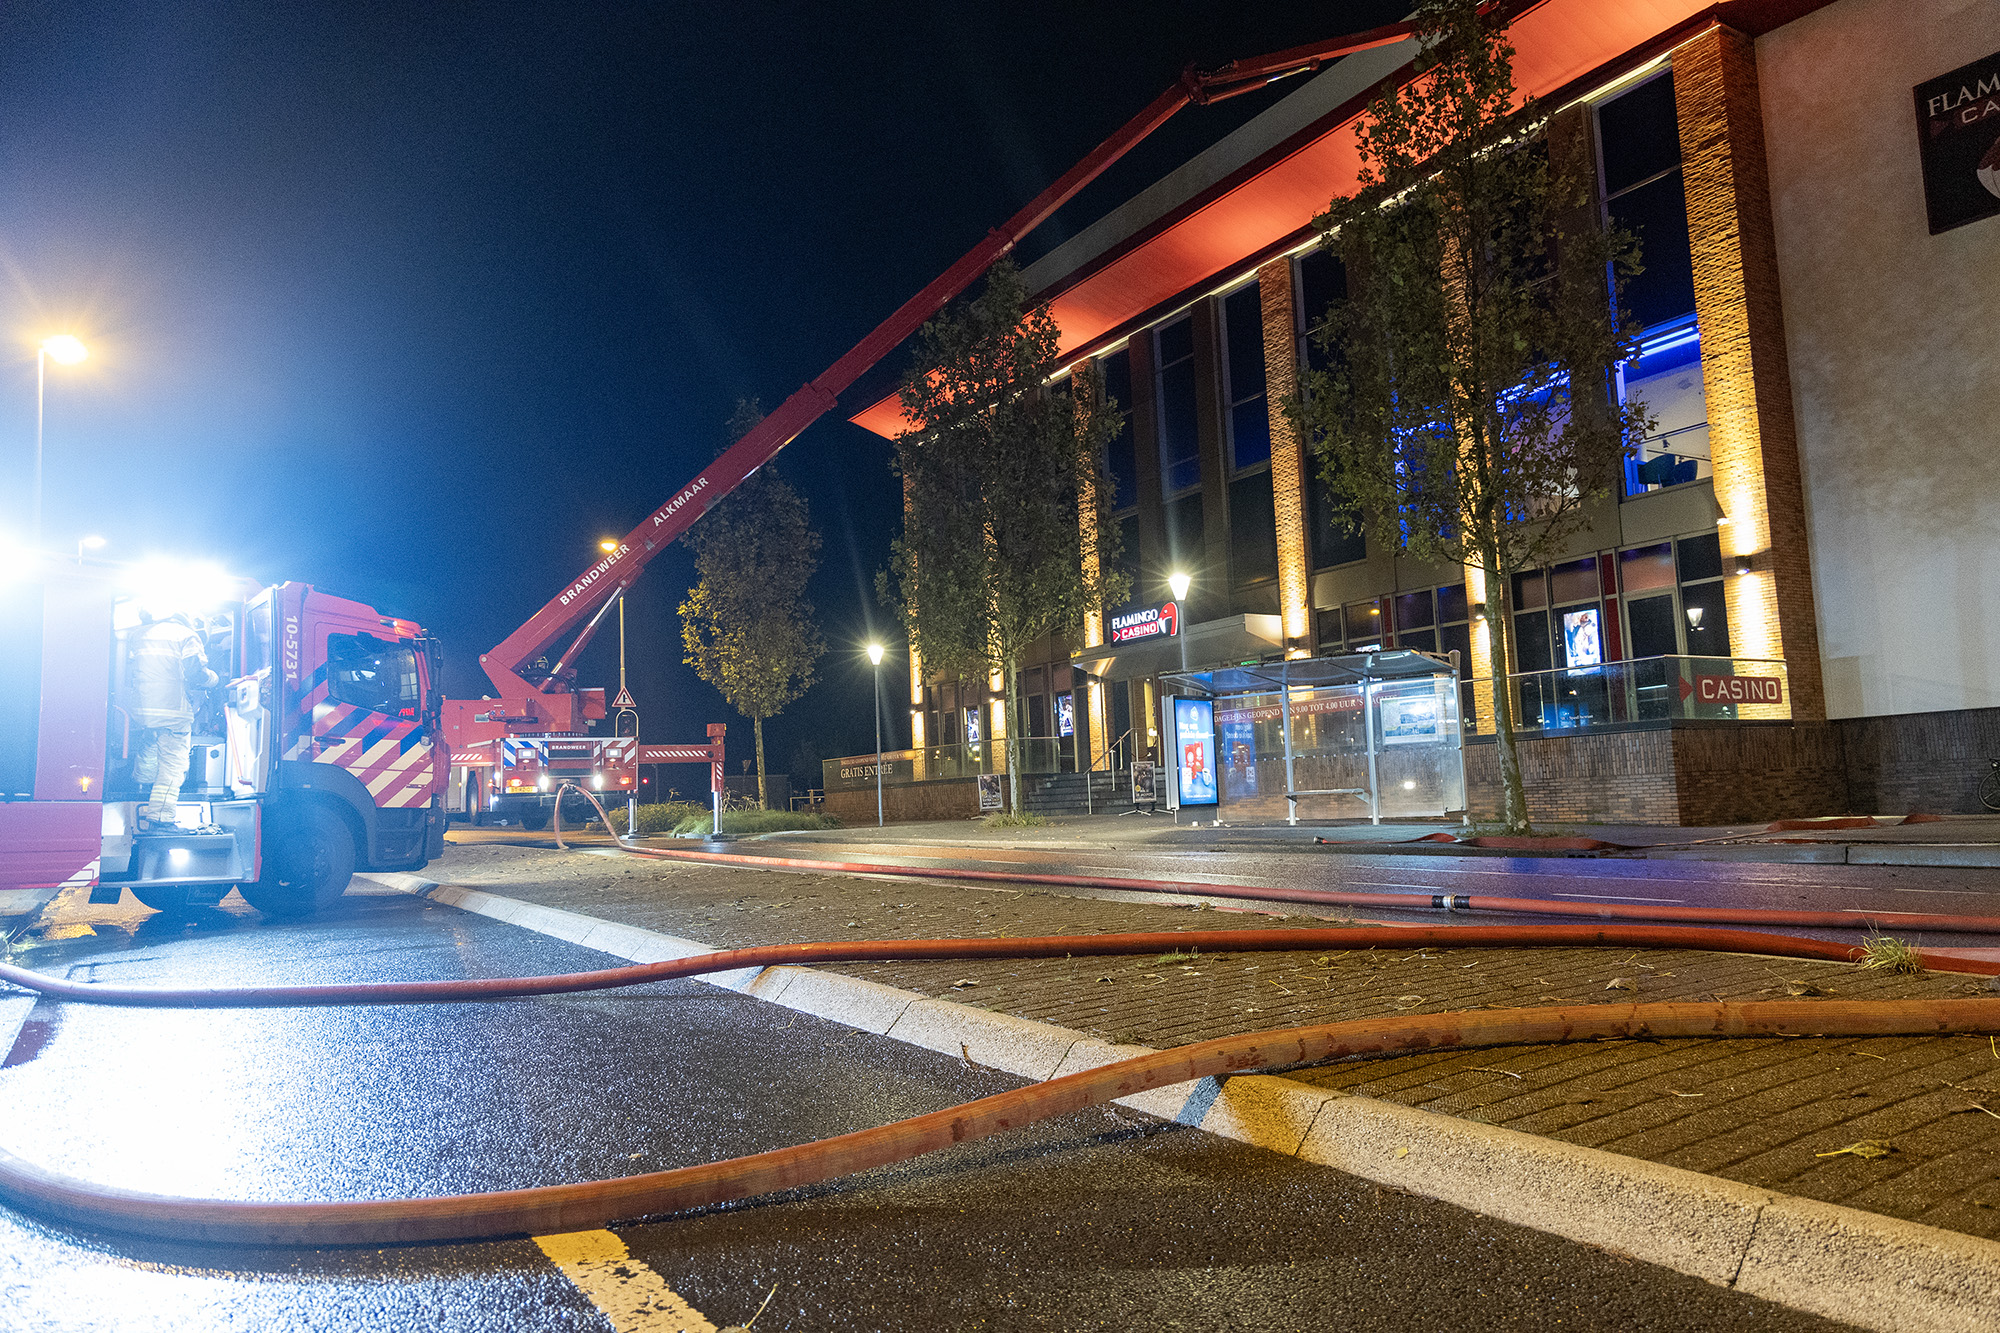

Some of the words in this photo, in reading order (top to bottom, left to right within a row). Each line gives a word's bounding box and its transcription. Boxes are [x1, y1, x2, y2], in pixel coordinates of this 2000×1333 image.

[652, 476, 709, 527] ALKMAAR
[559, 543, 630, 606] BRANDWEER
[1112, 609, 1158, 629] FLAMINGO
[1121, 623, 1156, 639] CASINO
[286, 615, 298, 680] 10-5731
[1701, 678, 1779, 701] CASINO
[1247, 708, 1280, 719] GEOPEND
[1296, 705, 1308, 713] 9.00
[1308, 703, 1324, 712] TOT
[1339, 699, 1356, 708] UUR
[840, 766, 864, 779] GRATIS
